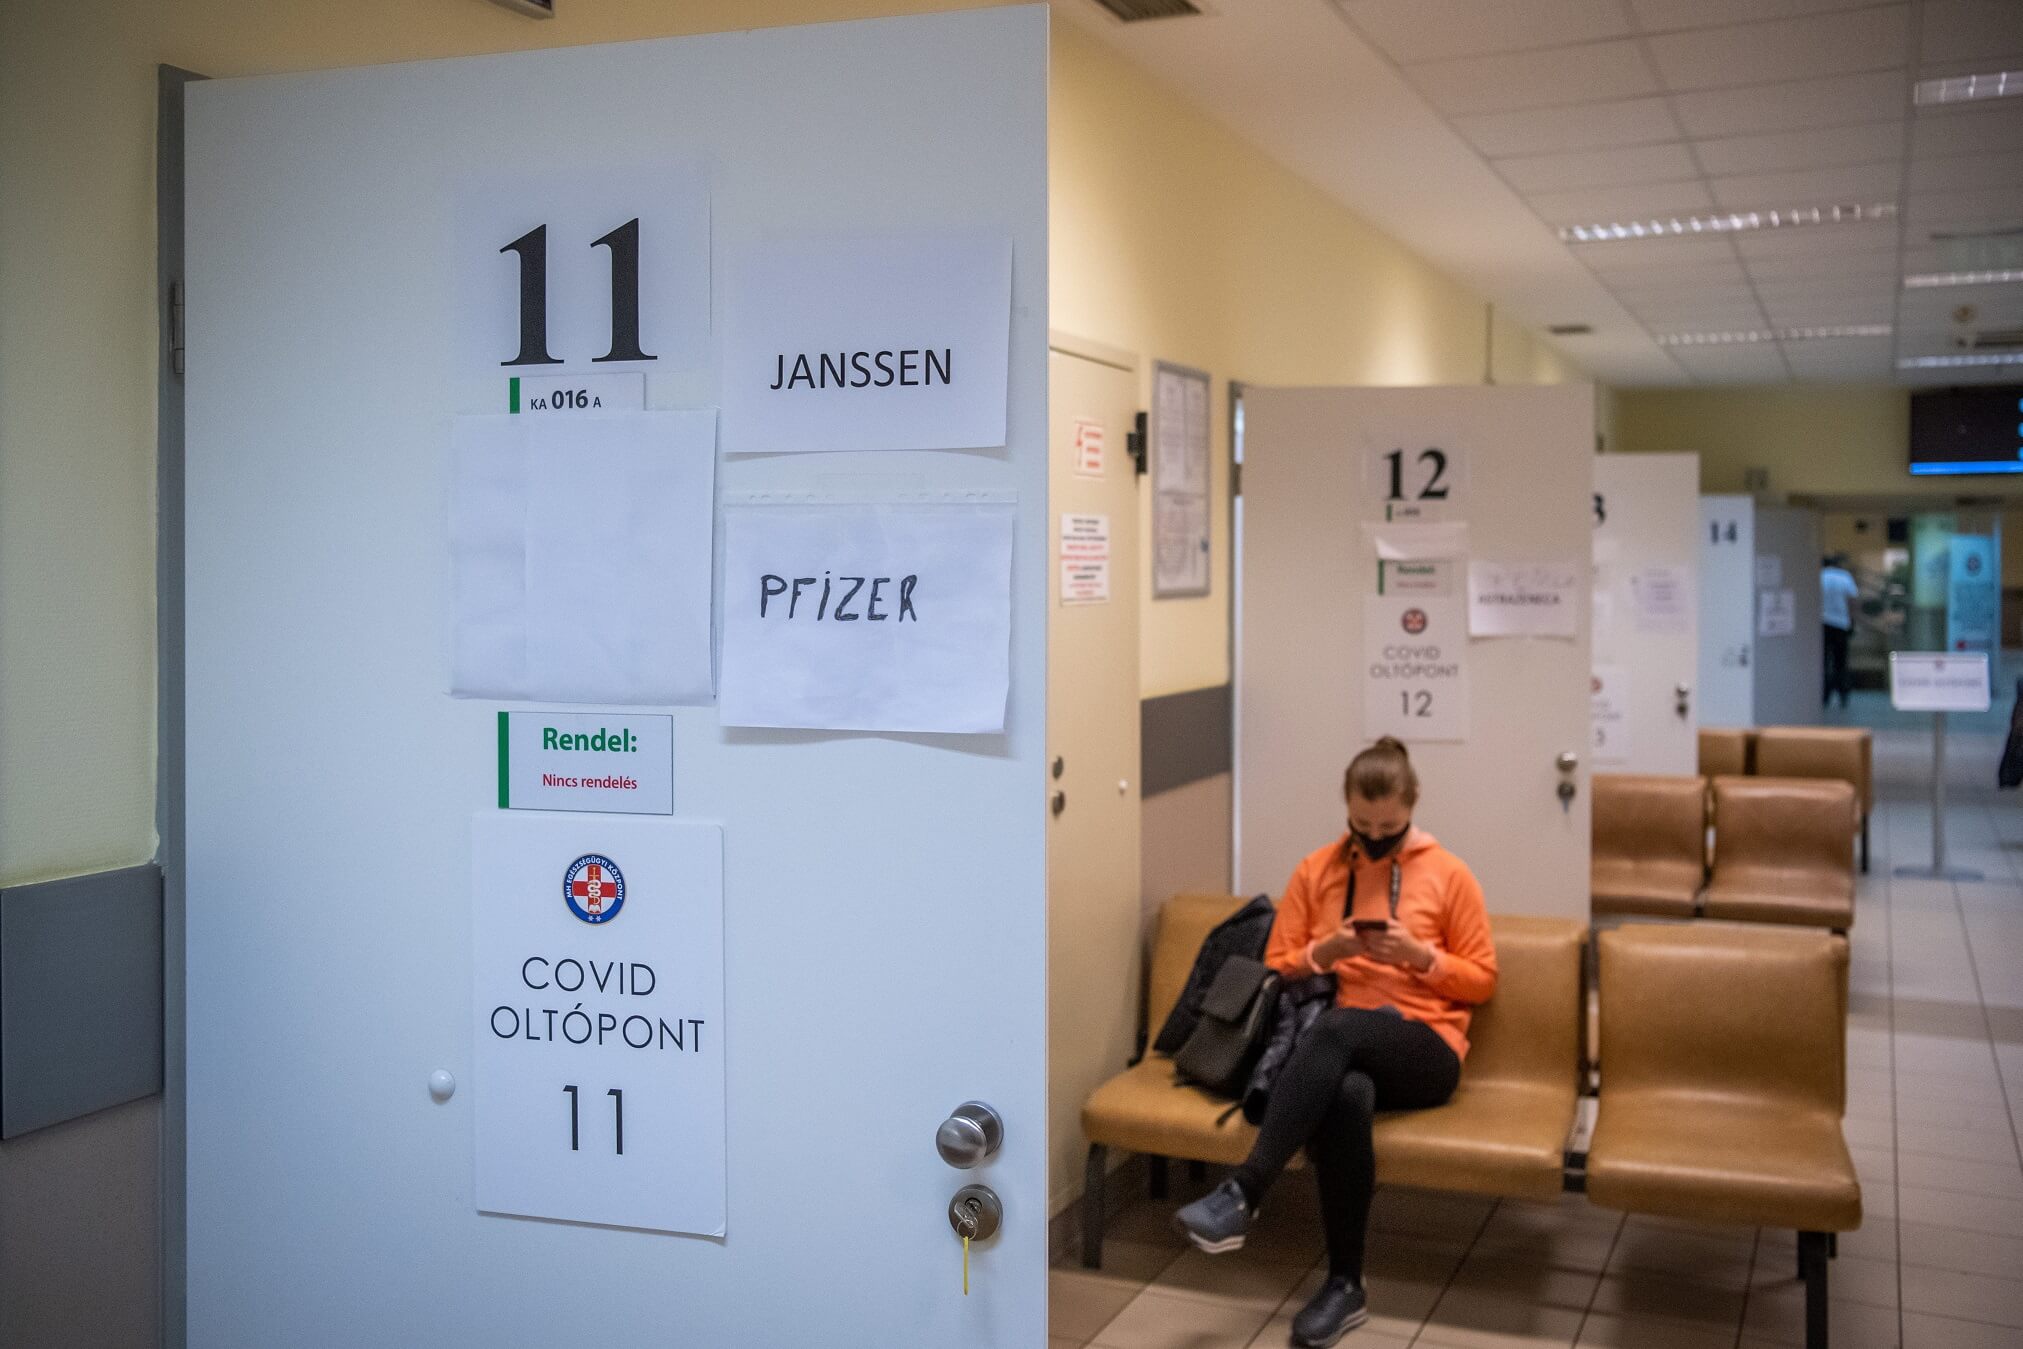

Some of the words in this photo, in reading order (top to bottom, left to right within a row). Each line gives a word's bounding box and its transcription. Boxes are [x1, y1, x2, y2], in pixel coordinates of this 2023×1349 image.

[499, 217, 658, 367] 11
[770, 347, 952, 390] JANSSEN
[530, 398, 547, 411] KA
[551, 389, 589, 410] 016
[592, 396, 602, 408] A
[1383, 447, 1450, 501] 12
[1382, 645, 1442, 661] COVID
[1401, 689, 1433, 718] 12
[543, 727, 638, 753] Rendel:
[542, 773, 578, 788] Nincs
[581, 776, 638, 790] rendelés
[565, 885, 573, 898] MH
[521, 955, 656, 997] COVID
[490, 1002, 705, 1054] OLTÓPONT
[562, 1084, 624, 1156] 11
